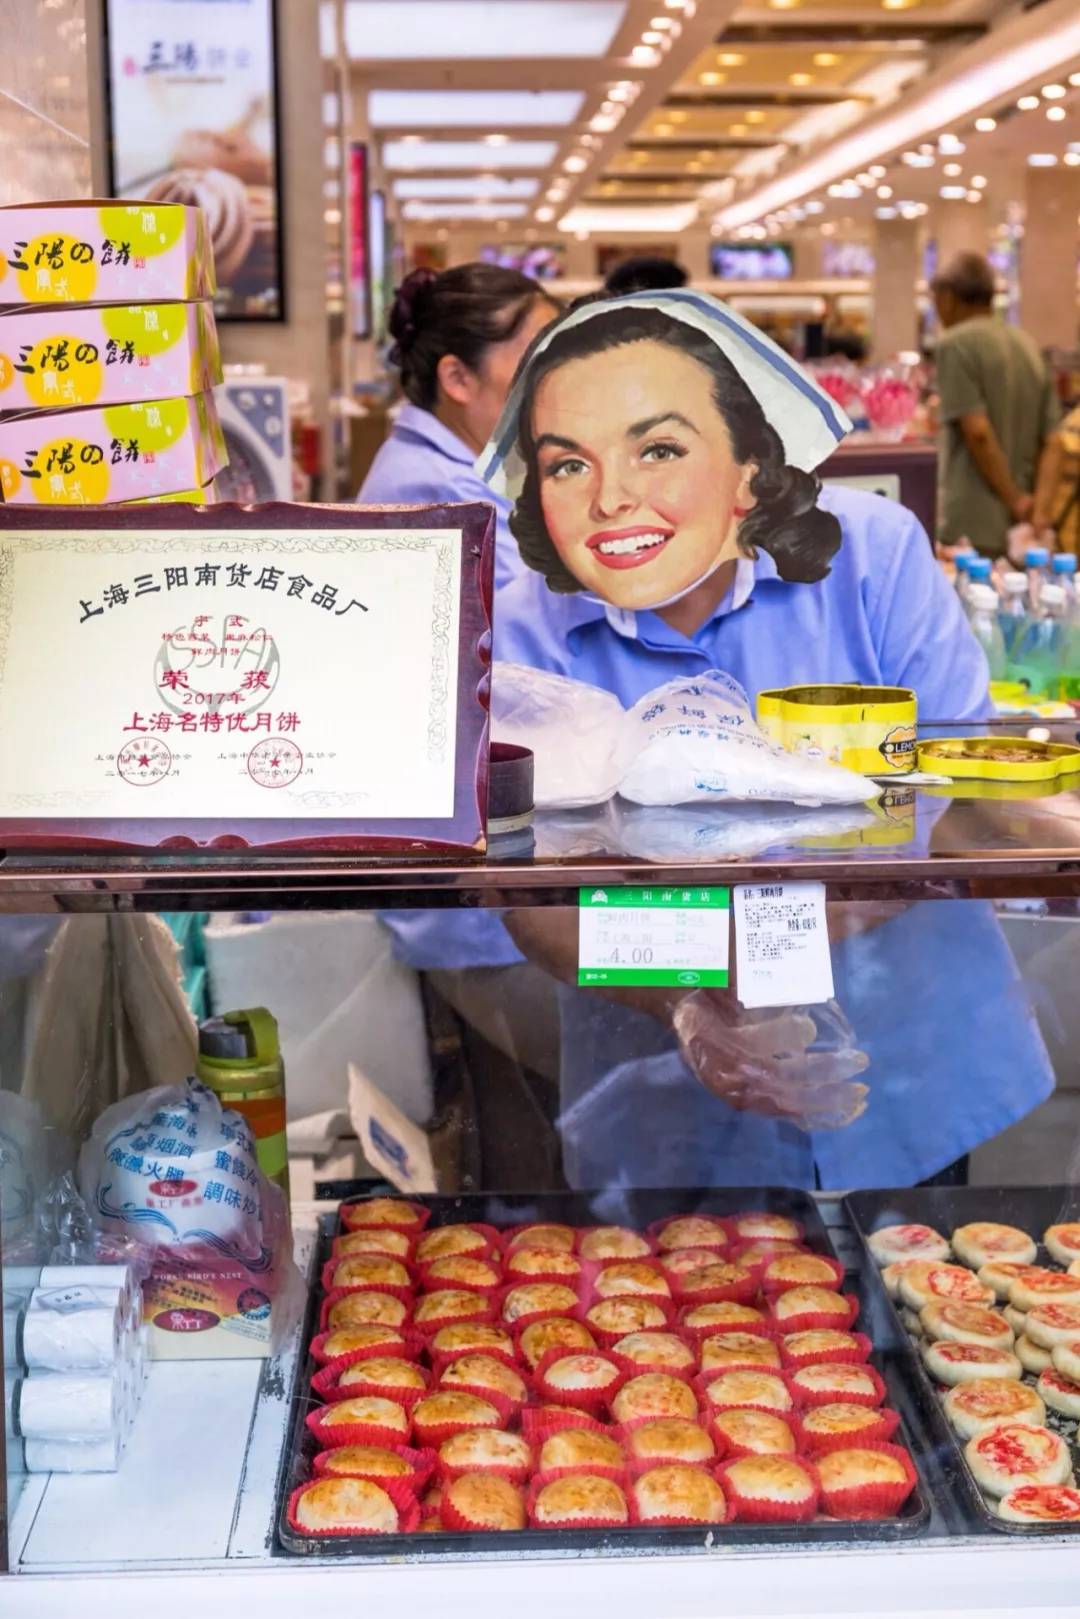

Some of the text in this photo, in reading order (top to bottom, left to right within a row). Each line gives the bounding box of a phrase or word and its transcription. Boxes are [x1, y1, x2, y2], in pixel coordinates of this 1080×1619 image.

[8, 239, 131, 270] 三陽の餅
[14, 339, 135, 373] 三陽の餅
[20, 439, 139, 478] 三陽の餅
[79, 562, 369, 623] 上海三阳南货店食品厂
[159, 670, 271, 690] 荣 获
[183, 692, 246, 705] 2017年
[123, 711, 301, 733] 上海名特优月饼
[610, 946, 654, 964] 4.00
